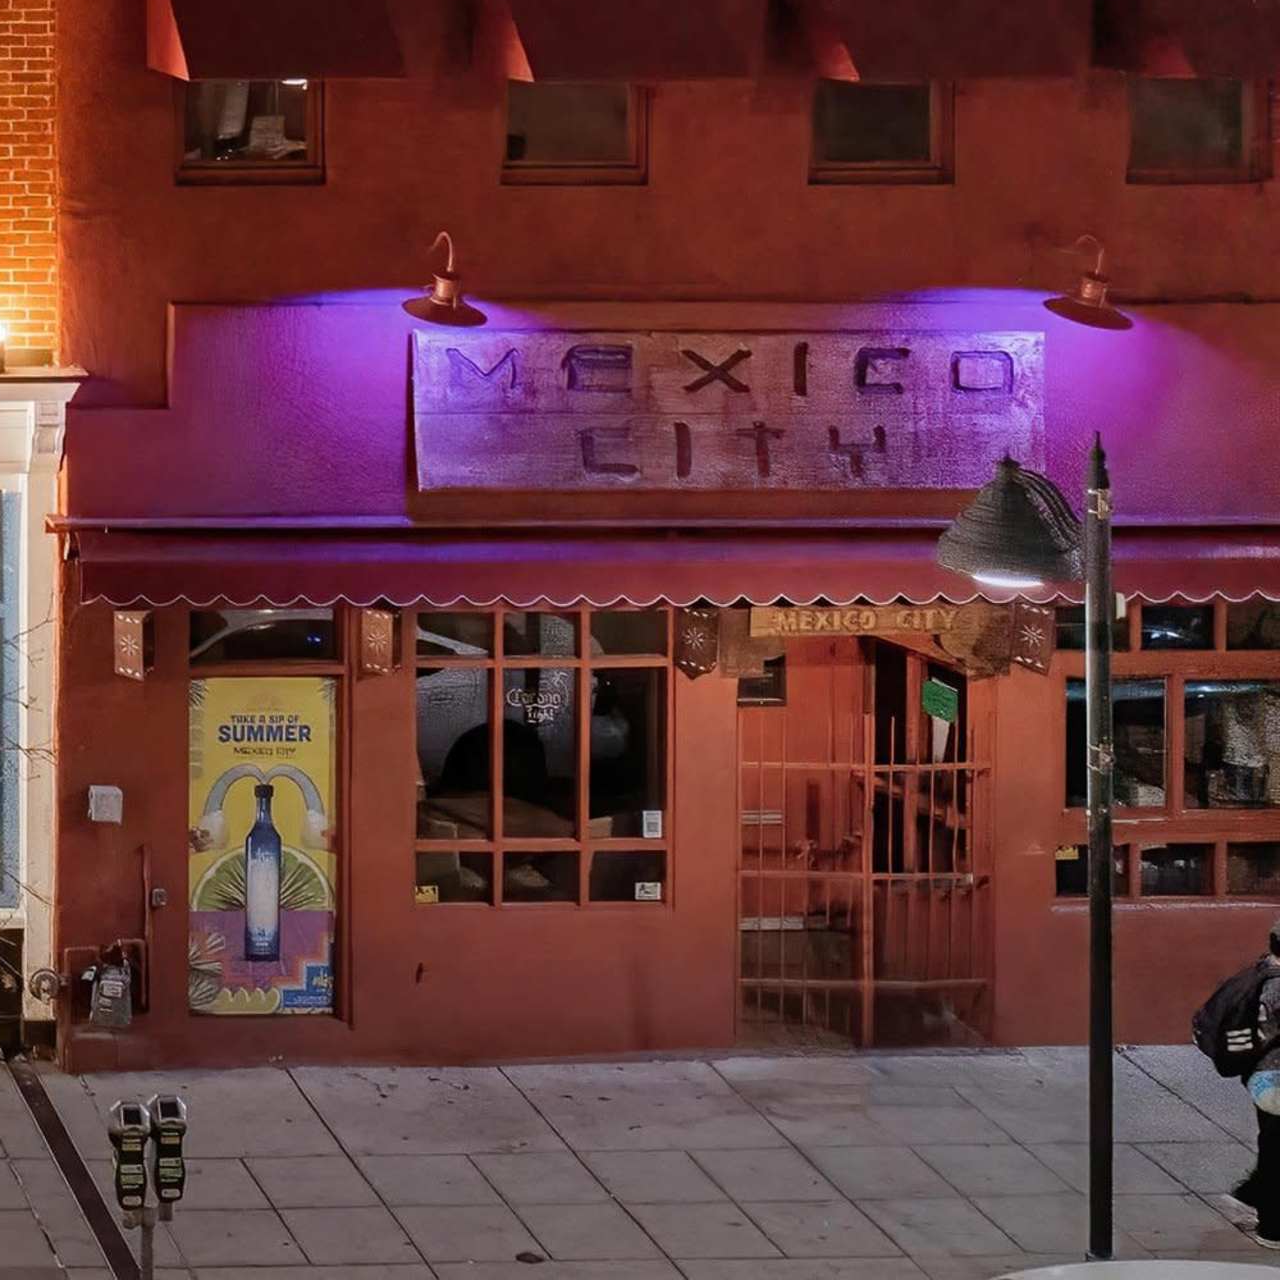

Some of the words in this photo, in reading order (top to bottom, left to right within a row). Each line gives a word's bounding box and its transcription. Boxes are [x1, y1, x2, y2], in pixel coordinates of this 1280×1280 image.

[445, 341, 1015, 397] MEXICO
[578, 420, 888, 480] CITY
[771, 609, 877, 632] MEXICO
[895, 609, 958, 631] CITY
[231, 714, 256, 724] TAKE
[269, 714, 284, 723] SIP
[287, 714, 299, 723] OF
[218, 724, 312, 742] SUMMER
